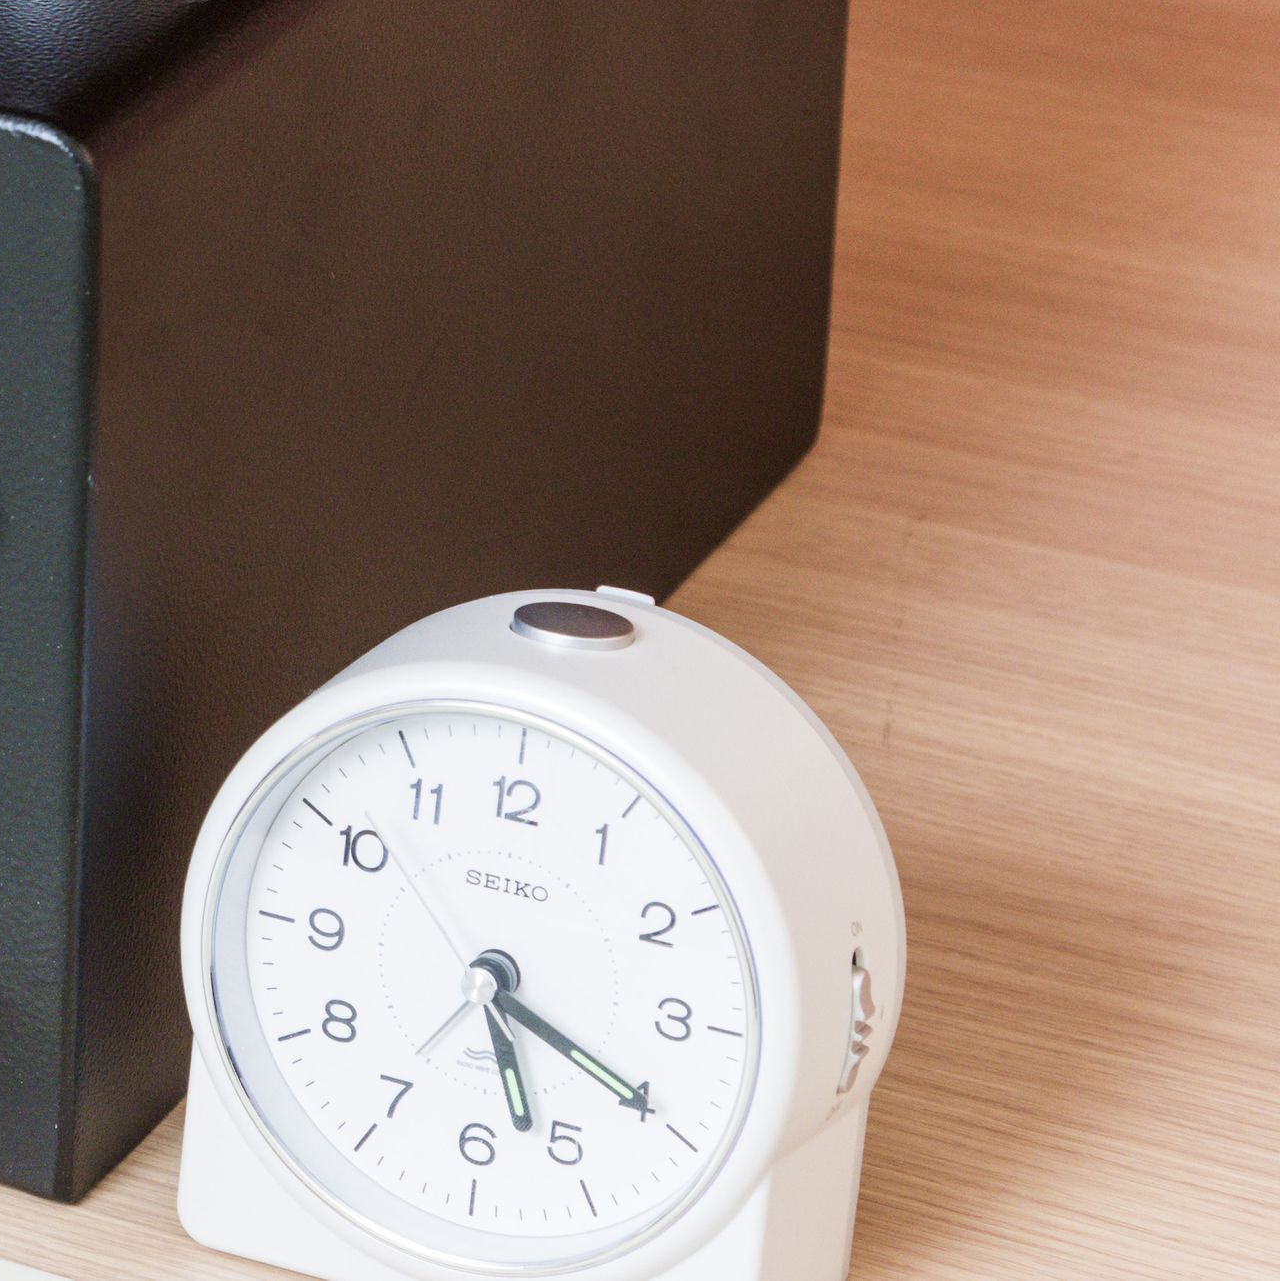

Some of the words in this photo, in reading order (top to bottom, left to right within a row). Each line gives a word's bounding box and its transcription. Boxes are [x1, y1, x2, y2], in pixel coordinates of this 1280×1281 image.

[409, 778, 442, 824] 11
[492, 775, 540, 826] 12
[339, 824, 388, 872] 10
[595, 823, 608, 865] 1
[466, 869, 548, 901] SEIKO
[307, 907, 344, 951] 9
[638, 901, 676, 947] 2
[321, 999, 357, 1042] 8
[654, 997, 692, 1041] 3
[380, 1074, 413, 1118] 7
[458, 1122, 496, 1165] 6
[547, 1119, 582, 1165] 5
